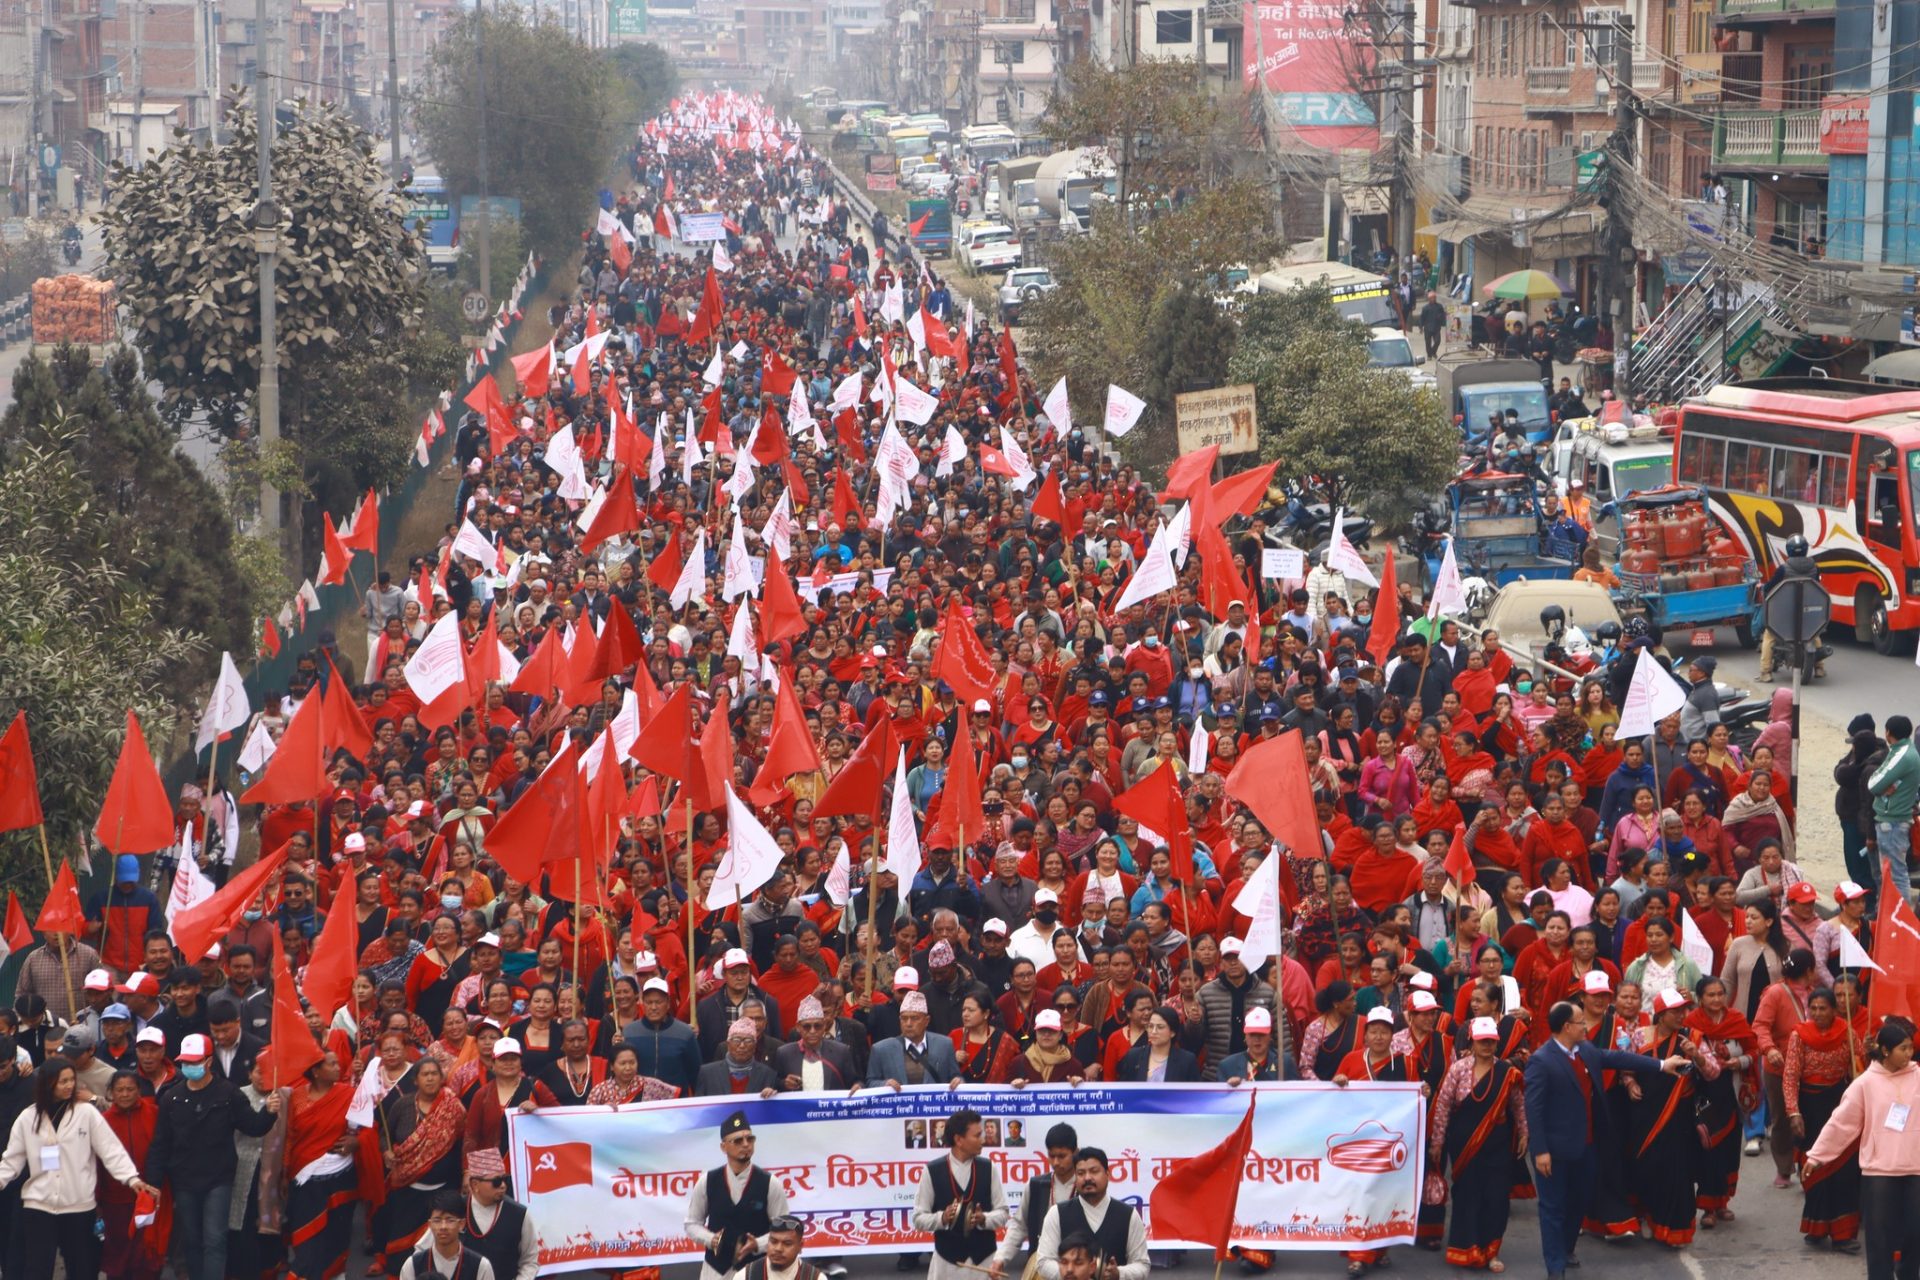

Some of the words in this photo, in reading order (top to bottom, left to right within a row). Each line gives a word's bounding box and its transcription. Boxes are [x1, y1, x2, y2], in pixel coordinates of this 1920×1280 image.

[1274, 28, 1292, 40] Tel
[923, 1104, 941, 1113] नेपाल
[612, 1167, 702, 1199] नेपाल
[826, 1154, 928, 1188] किसान
